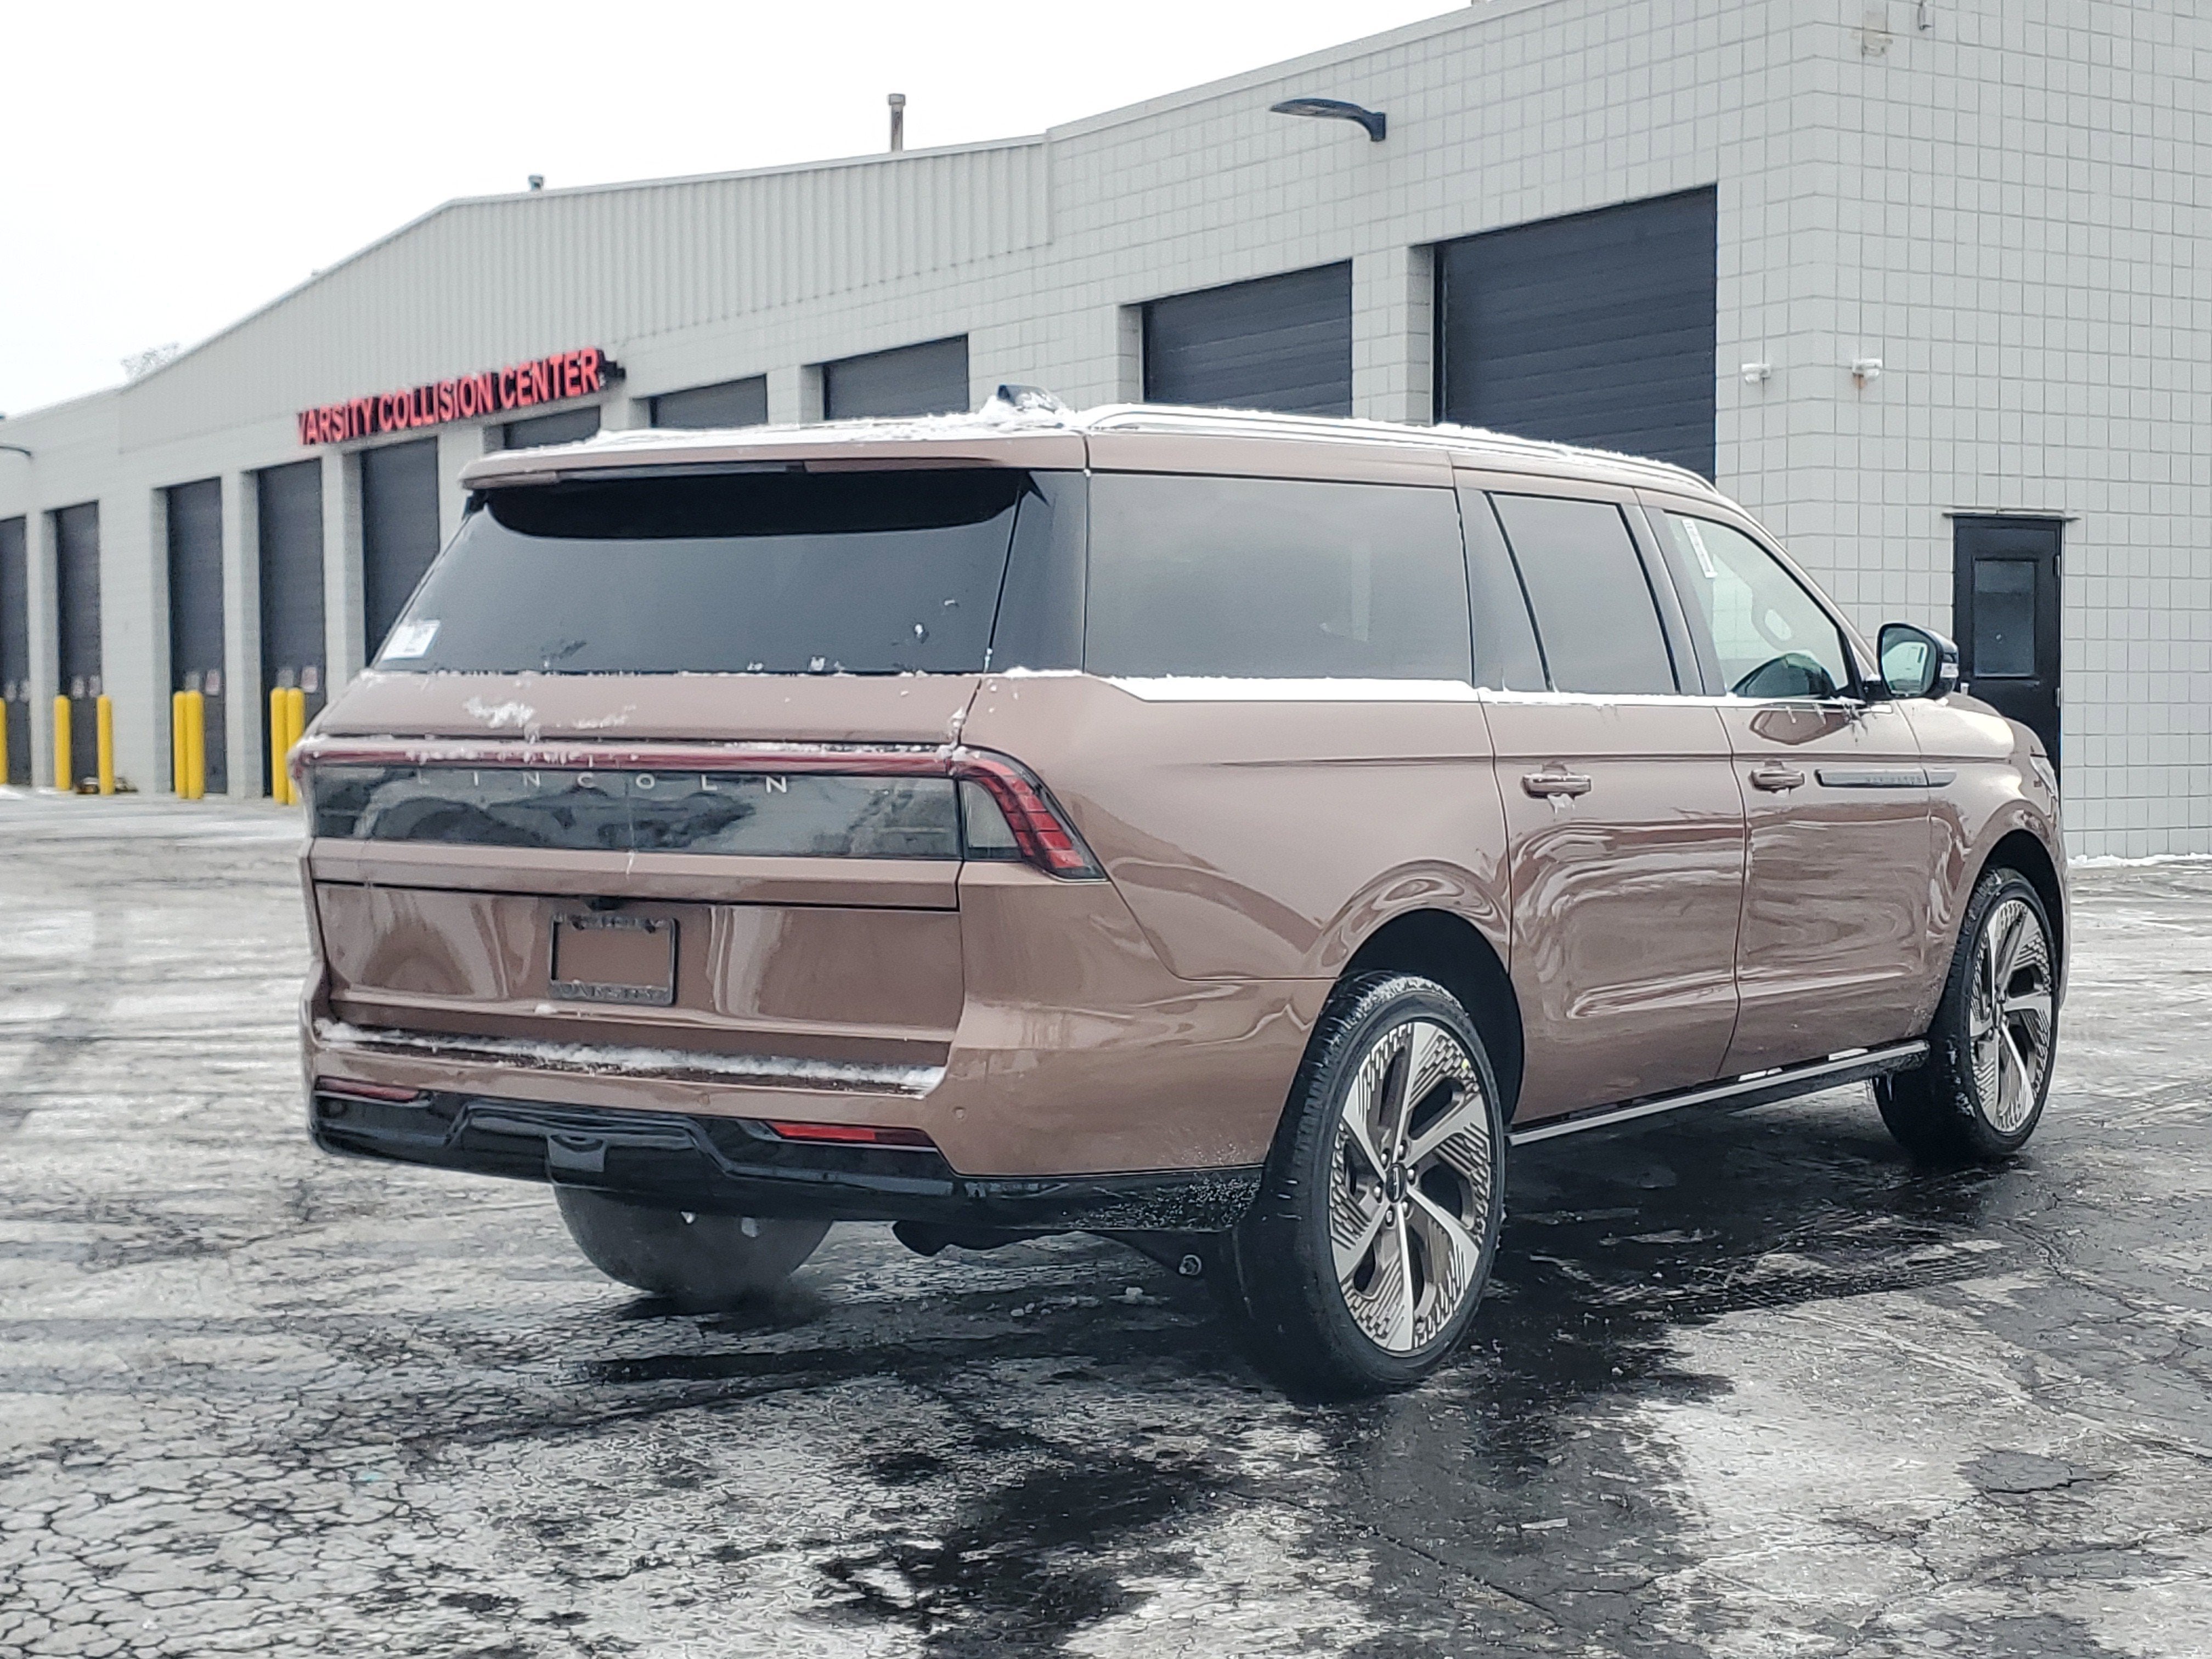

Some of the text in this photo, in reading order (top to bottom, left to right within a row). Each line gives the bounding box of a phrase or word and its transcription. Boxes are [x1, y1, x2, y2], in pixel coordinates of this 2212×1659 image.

[298, 347, 600, 444] VARSITY COLLISION CENTER
[416, 771, 787, 793] LINCOLN
